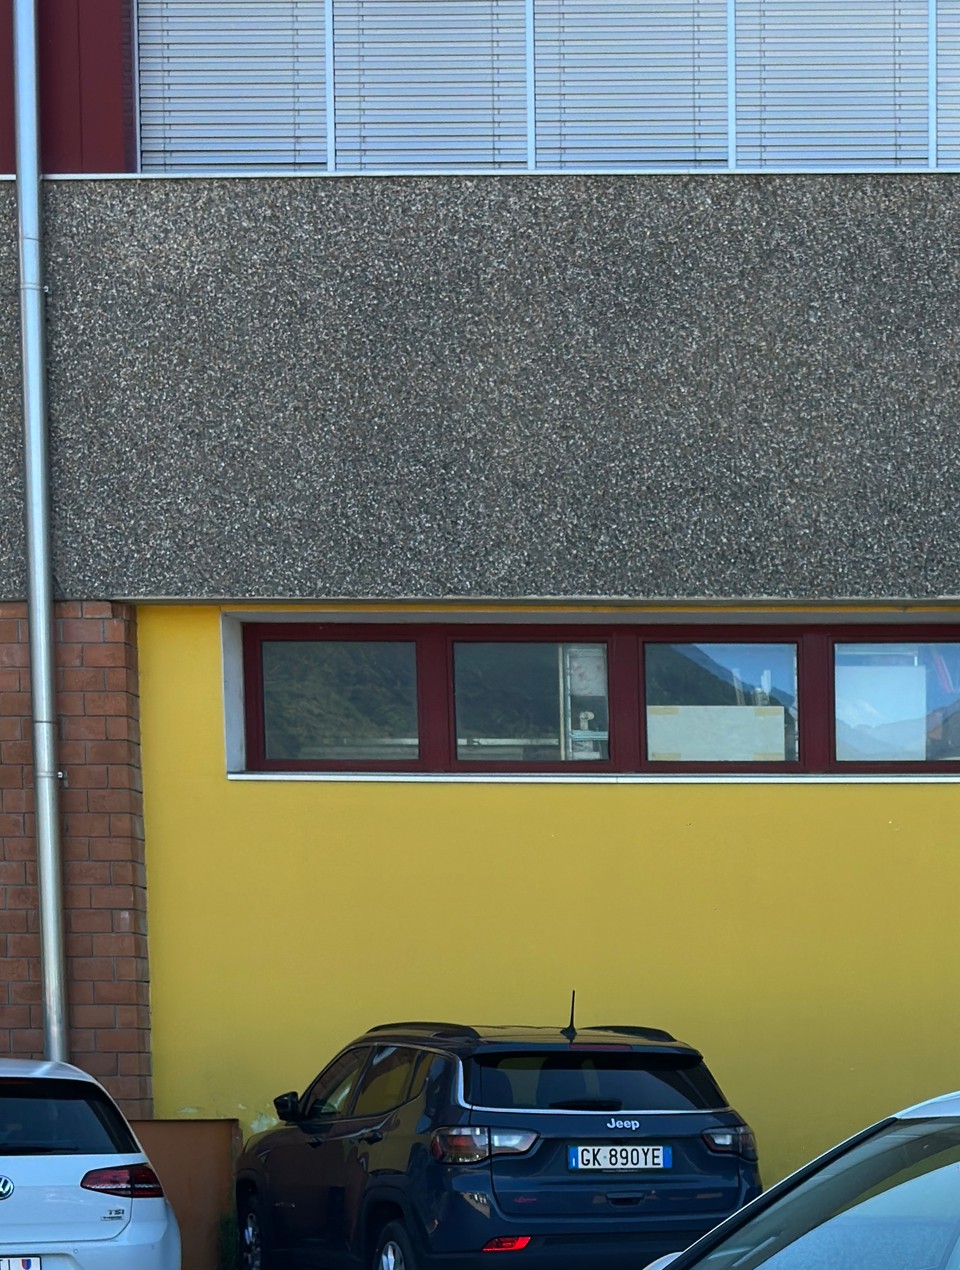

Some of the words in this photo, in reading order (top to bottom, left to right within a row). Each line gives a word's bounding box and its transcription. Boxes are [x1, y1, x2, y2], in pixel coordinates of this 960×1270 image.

[606, 1118, 640, 1131] Jeep
[581, 1148, 602, 1167] GK
[609, 1148, 661, 1167] 890YE
